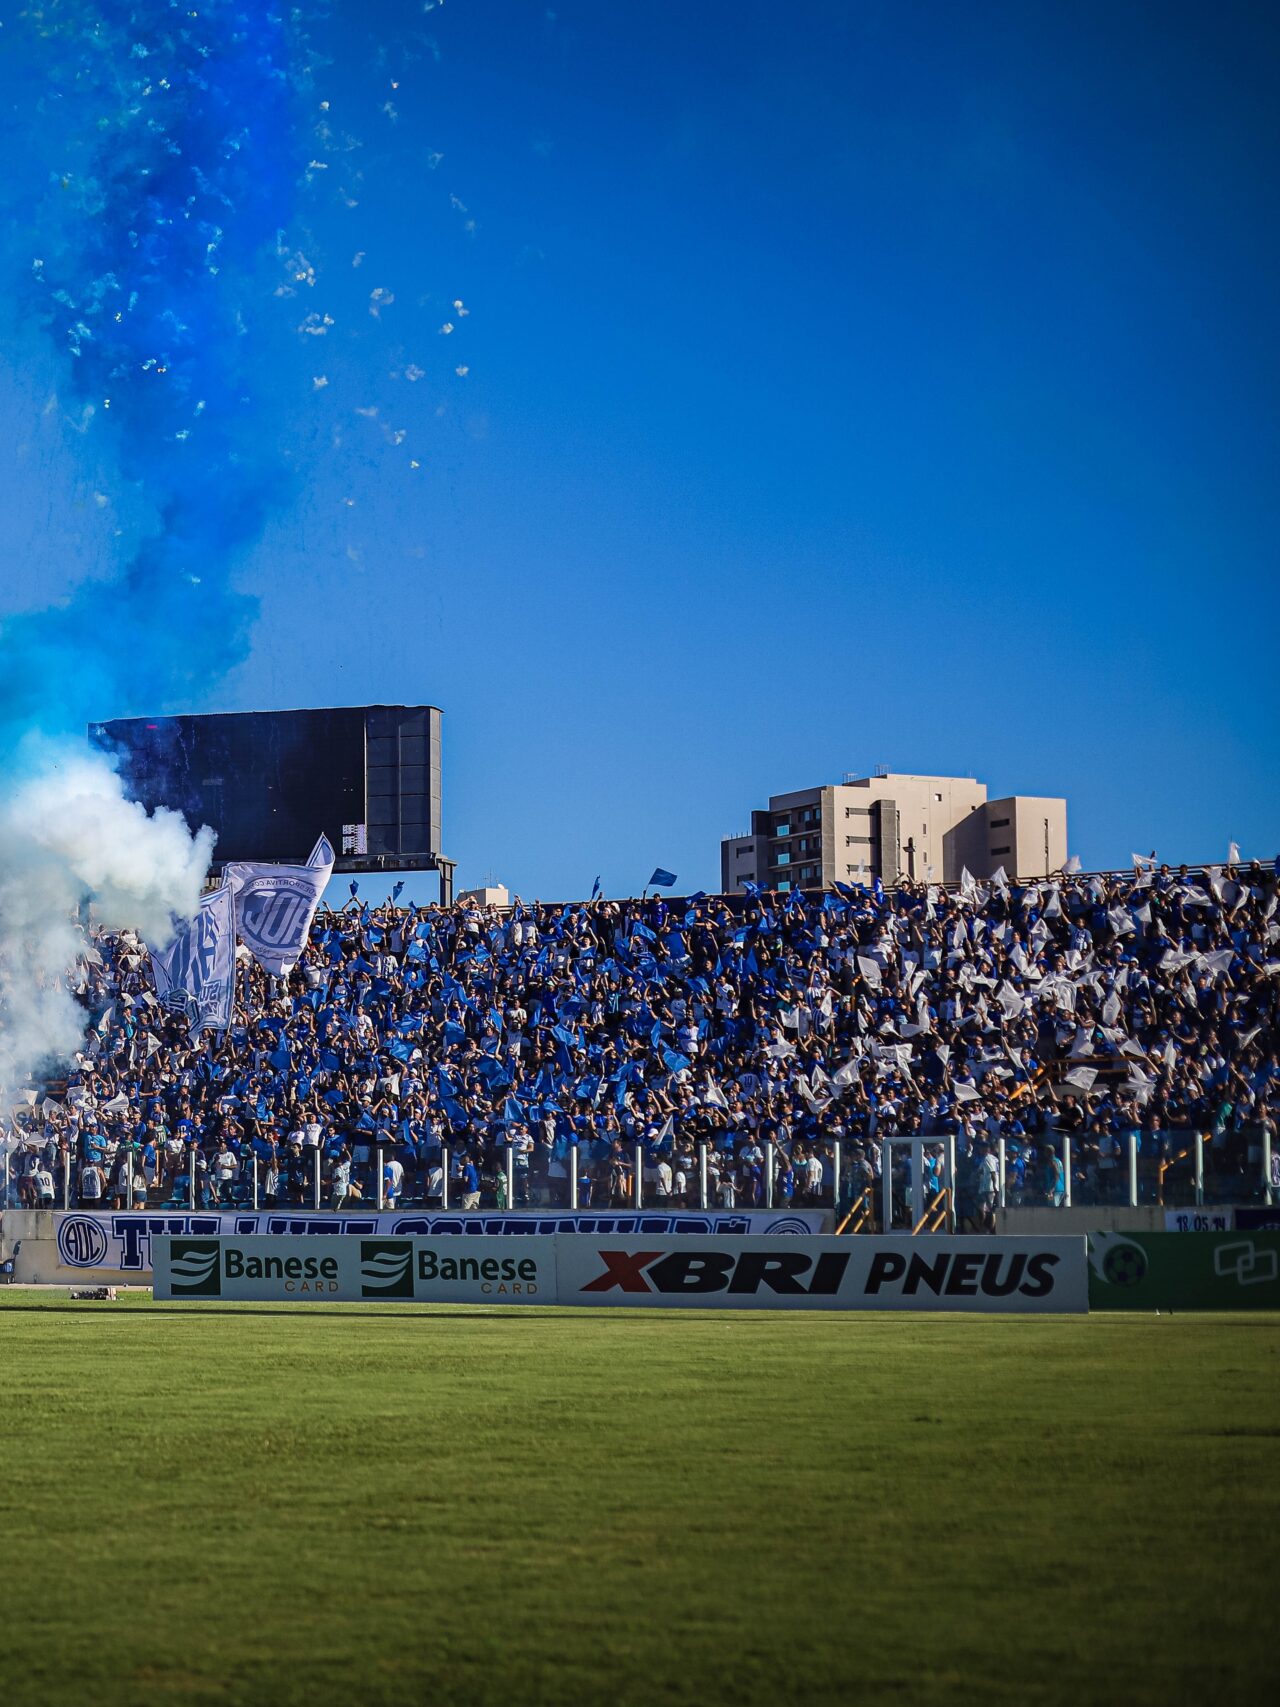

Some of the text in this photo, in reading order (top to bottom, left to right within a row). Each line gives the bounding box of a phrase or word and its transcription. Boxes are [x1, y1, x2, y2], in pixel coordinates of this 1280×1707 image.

[225, 1250, 338, 1279] Banese
[419, 1251, 537, 1281] Banese
[579, 1251, 1060, 1297] XBRI PNEUS
[285, 1281, 339, 1292] CARD
[481, 1283, 538, 1294] CARD
